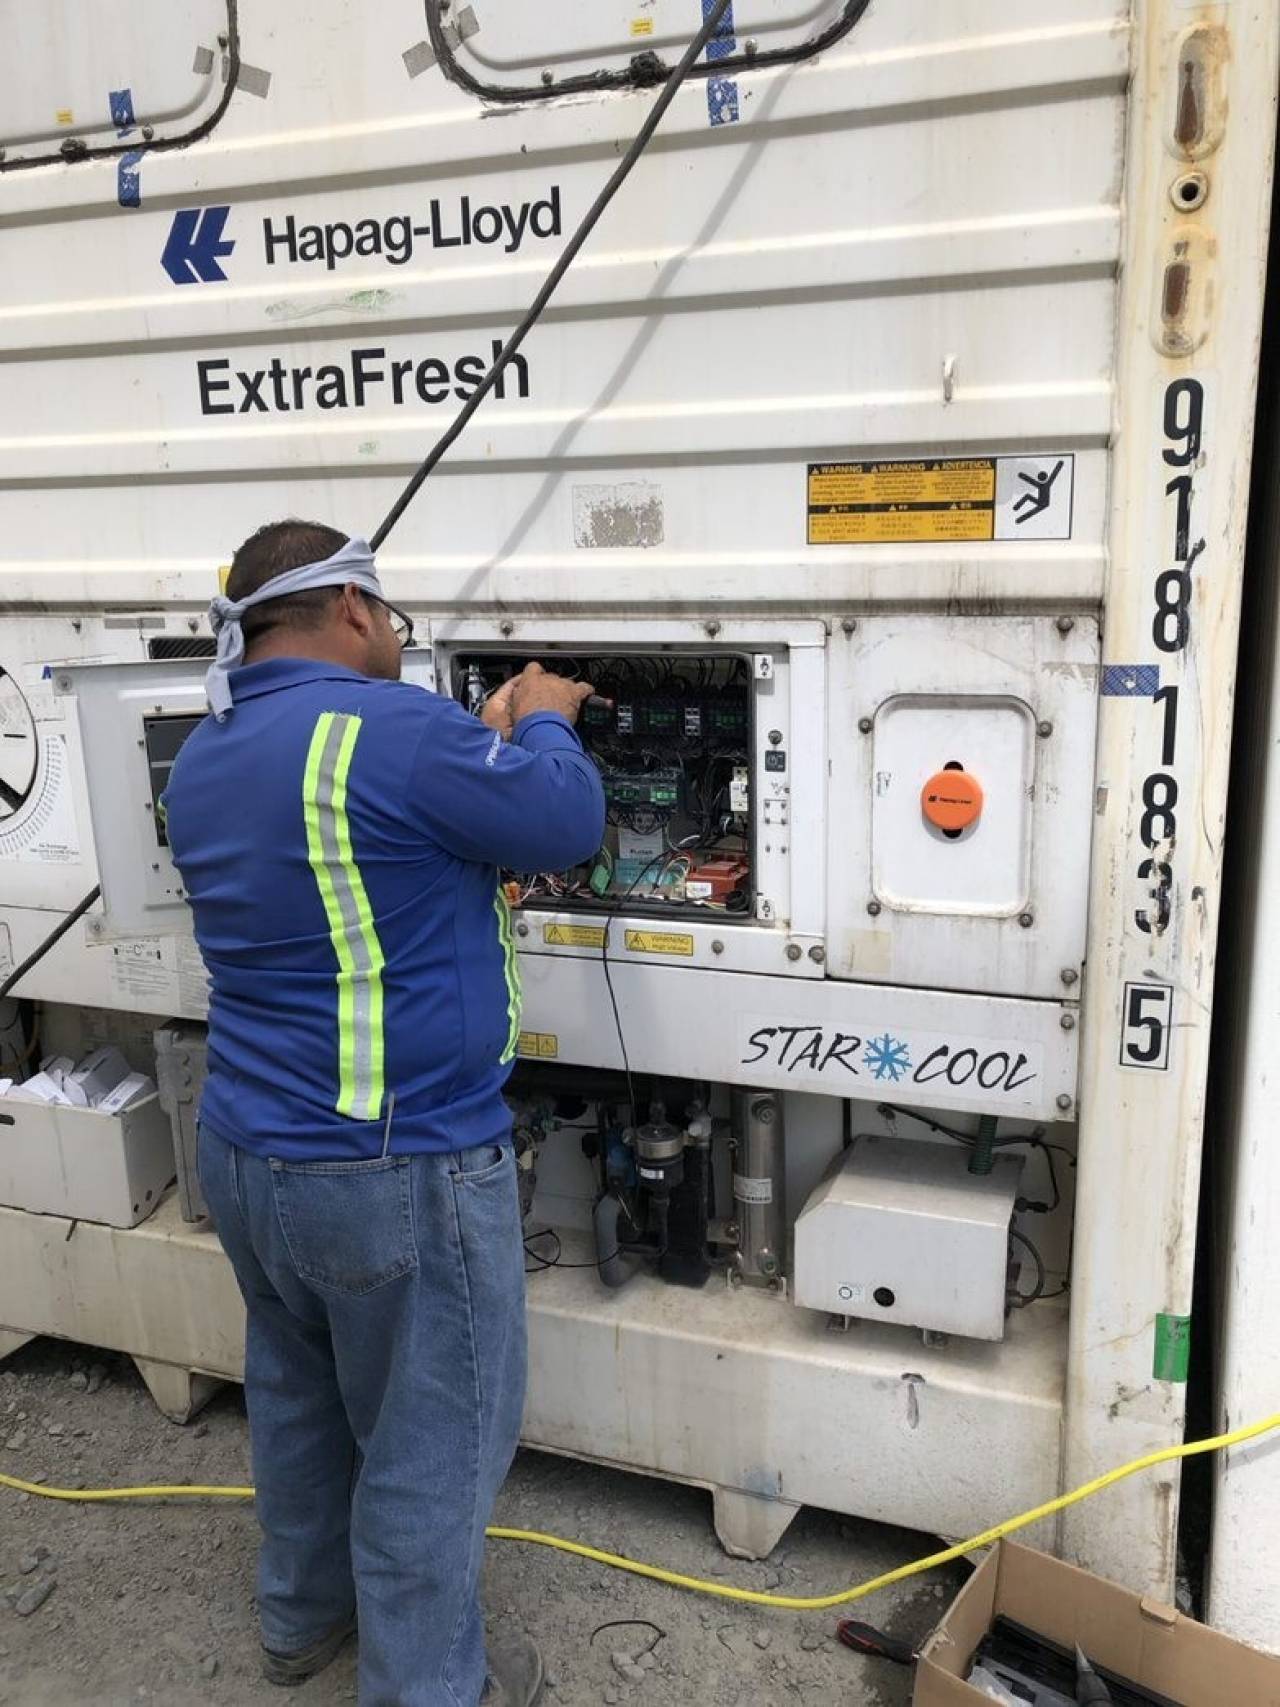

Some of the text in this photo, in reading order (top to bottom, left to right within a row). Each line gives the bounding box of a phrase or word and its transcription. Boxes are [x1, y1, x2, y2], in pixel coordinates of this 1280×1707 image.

[263, 186, 562, 270] Hapag-Lloyd
[198, 341, 529, 415] ExtraFresh
[742, 1026, 1037, 1092] STAR COOL
[1127, 988, 1165, 1062] 5
